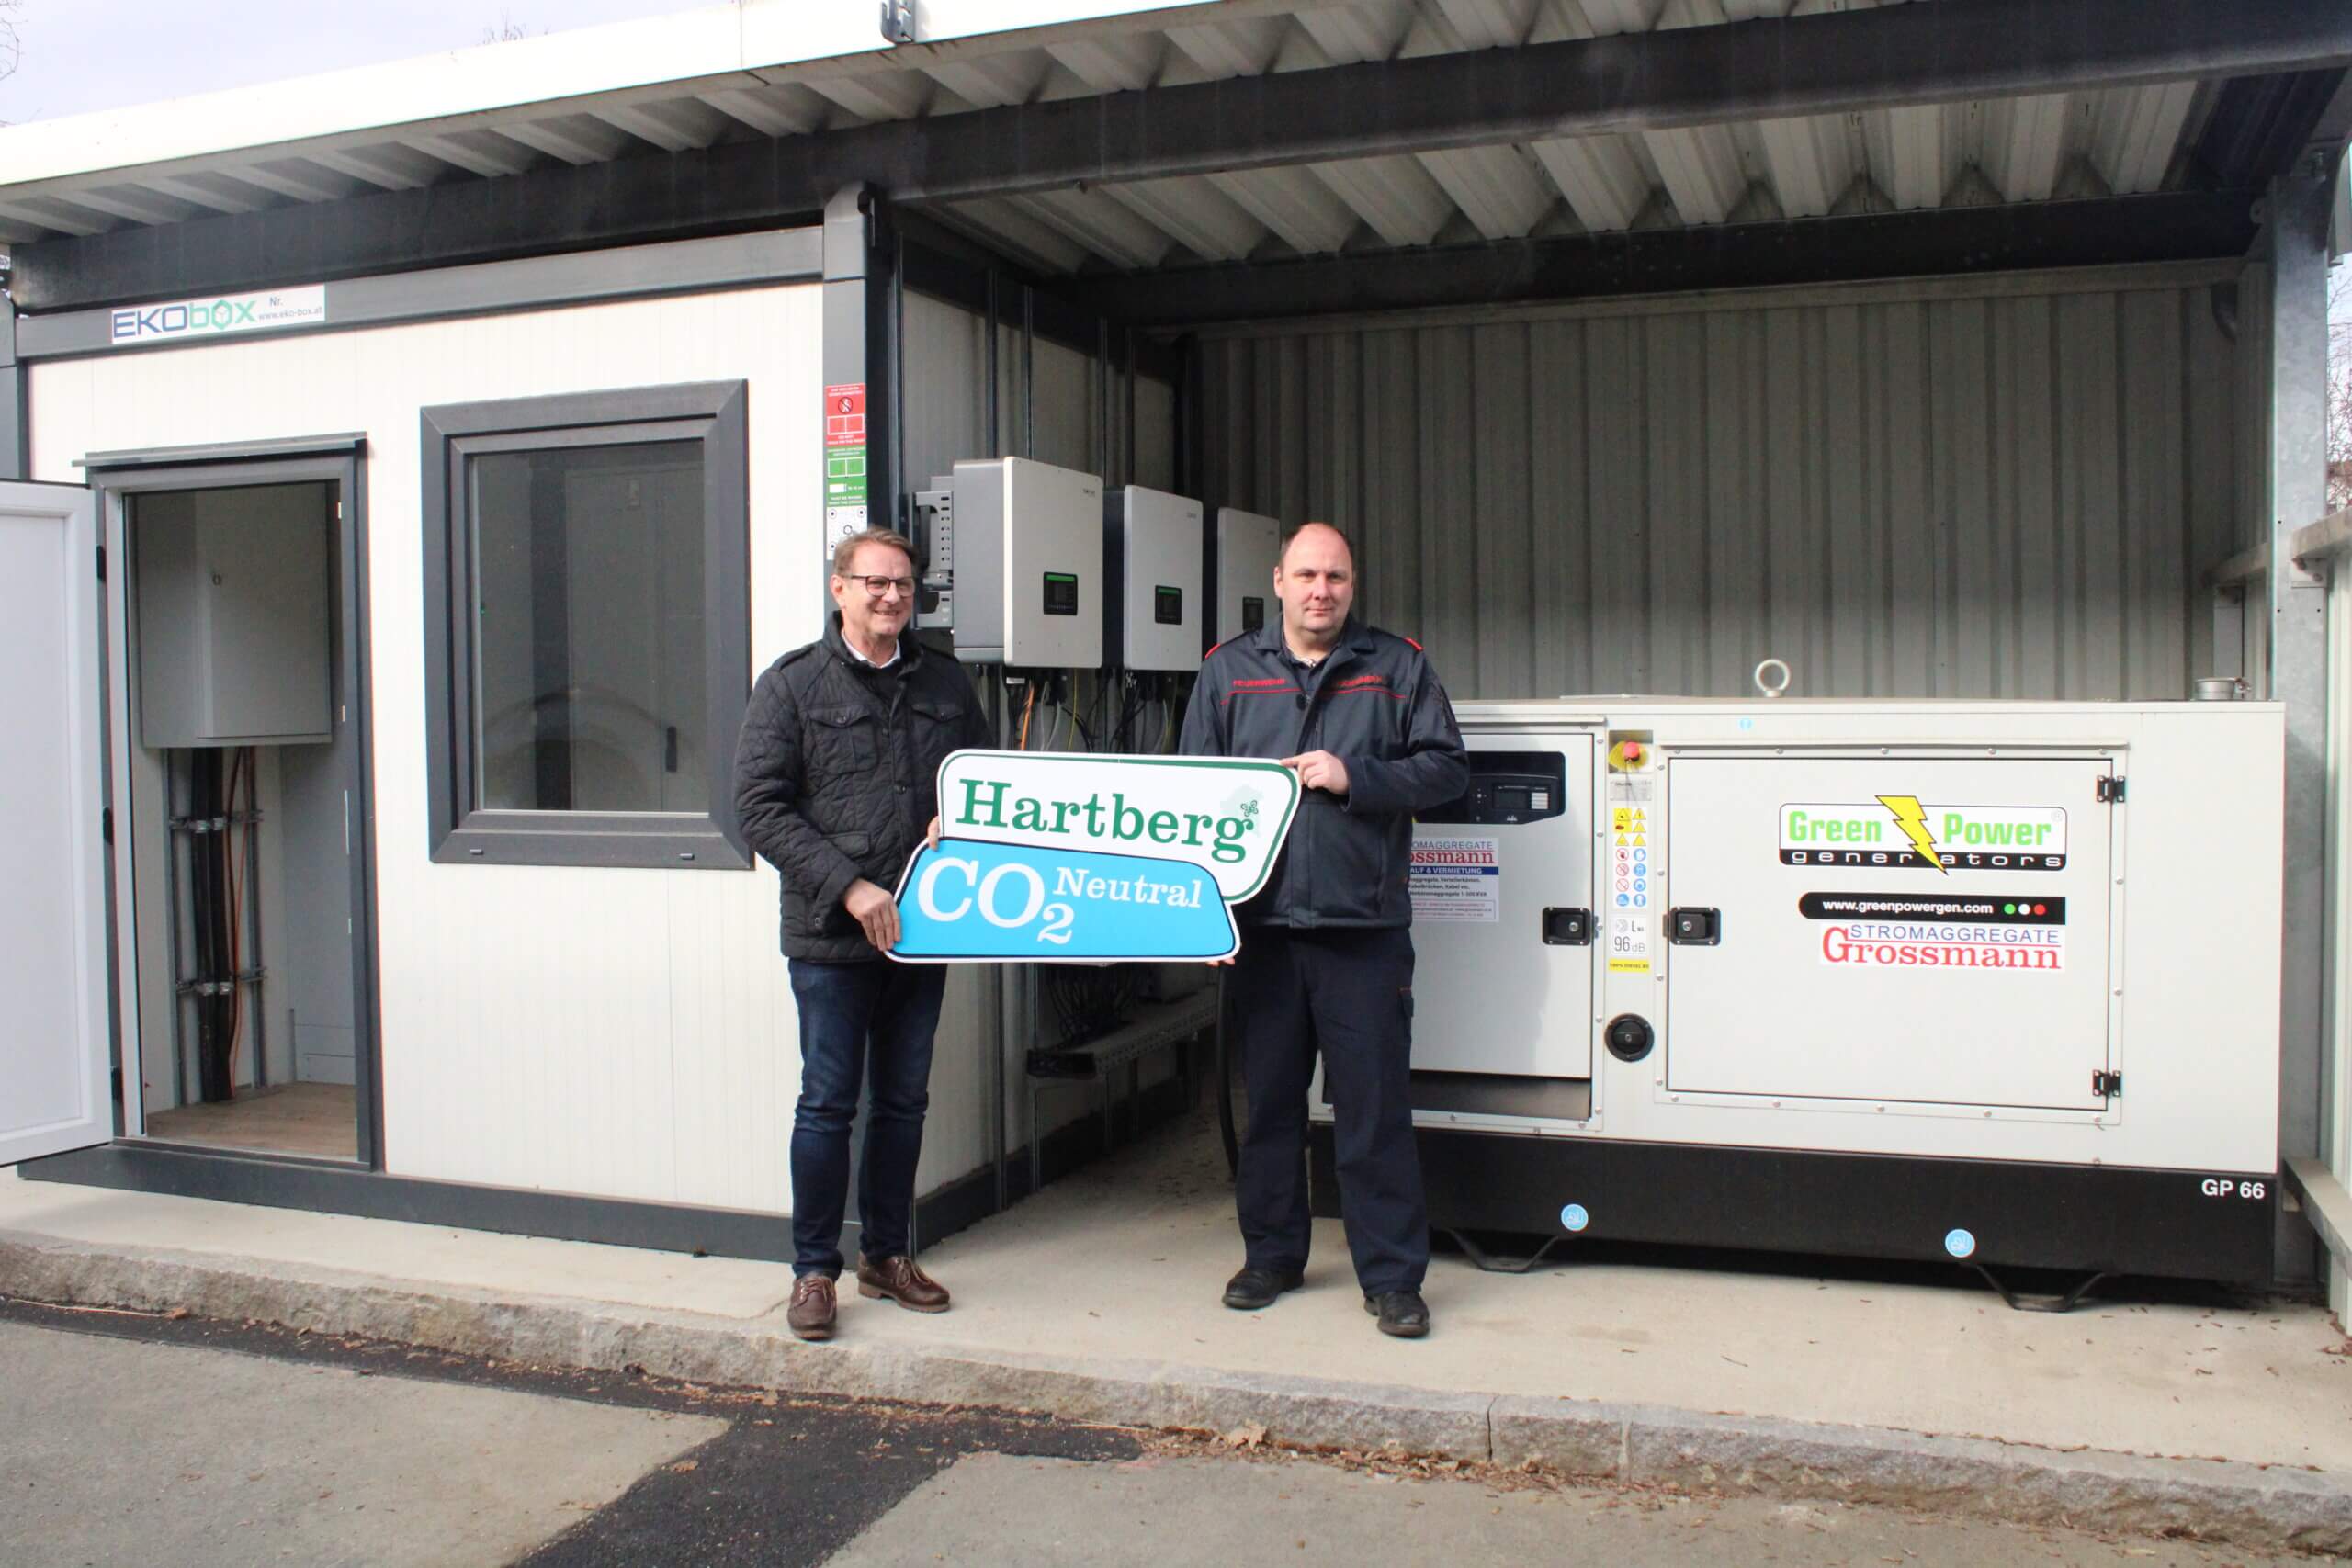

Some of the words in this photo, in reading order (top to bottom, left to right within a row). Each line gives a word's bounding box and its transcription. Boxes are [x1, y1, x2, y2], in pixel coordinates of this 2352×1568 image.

[955, 778, 1254, 863] Hartberg
[1788, 810, 1882, 843] Green
[1943, 812, 2052, 846] Power
[1411, 840, 1493, 851] OMAGGREGATE
[1791, 851, 2062, 868] generators
[1052, 866, 1202, 908] Neutral
[1822, 900, 1994, 914] www.greenpowergen.com
[1849, 924, 2059, 943] STROMAGGREGATE
[1614, 935, 1631, 952] 96
[1632, 942, 1645, 953] dB
[1822, 926, 2062, 969] Grossmann
[2201, 1179, 2233, 1197] GP
[2239, 1181, 2266, 1200] 66
